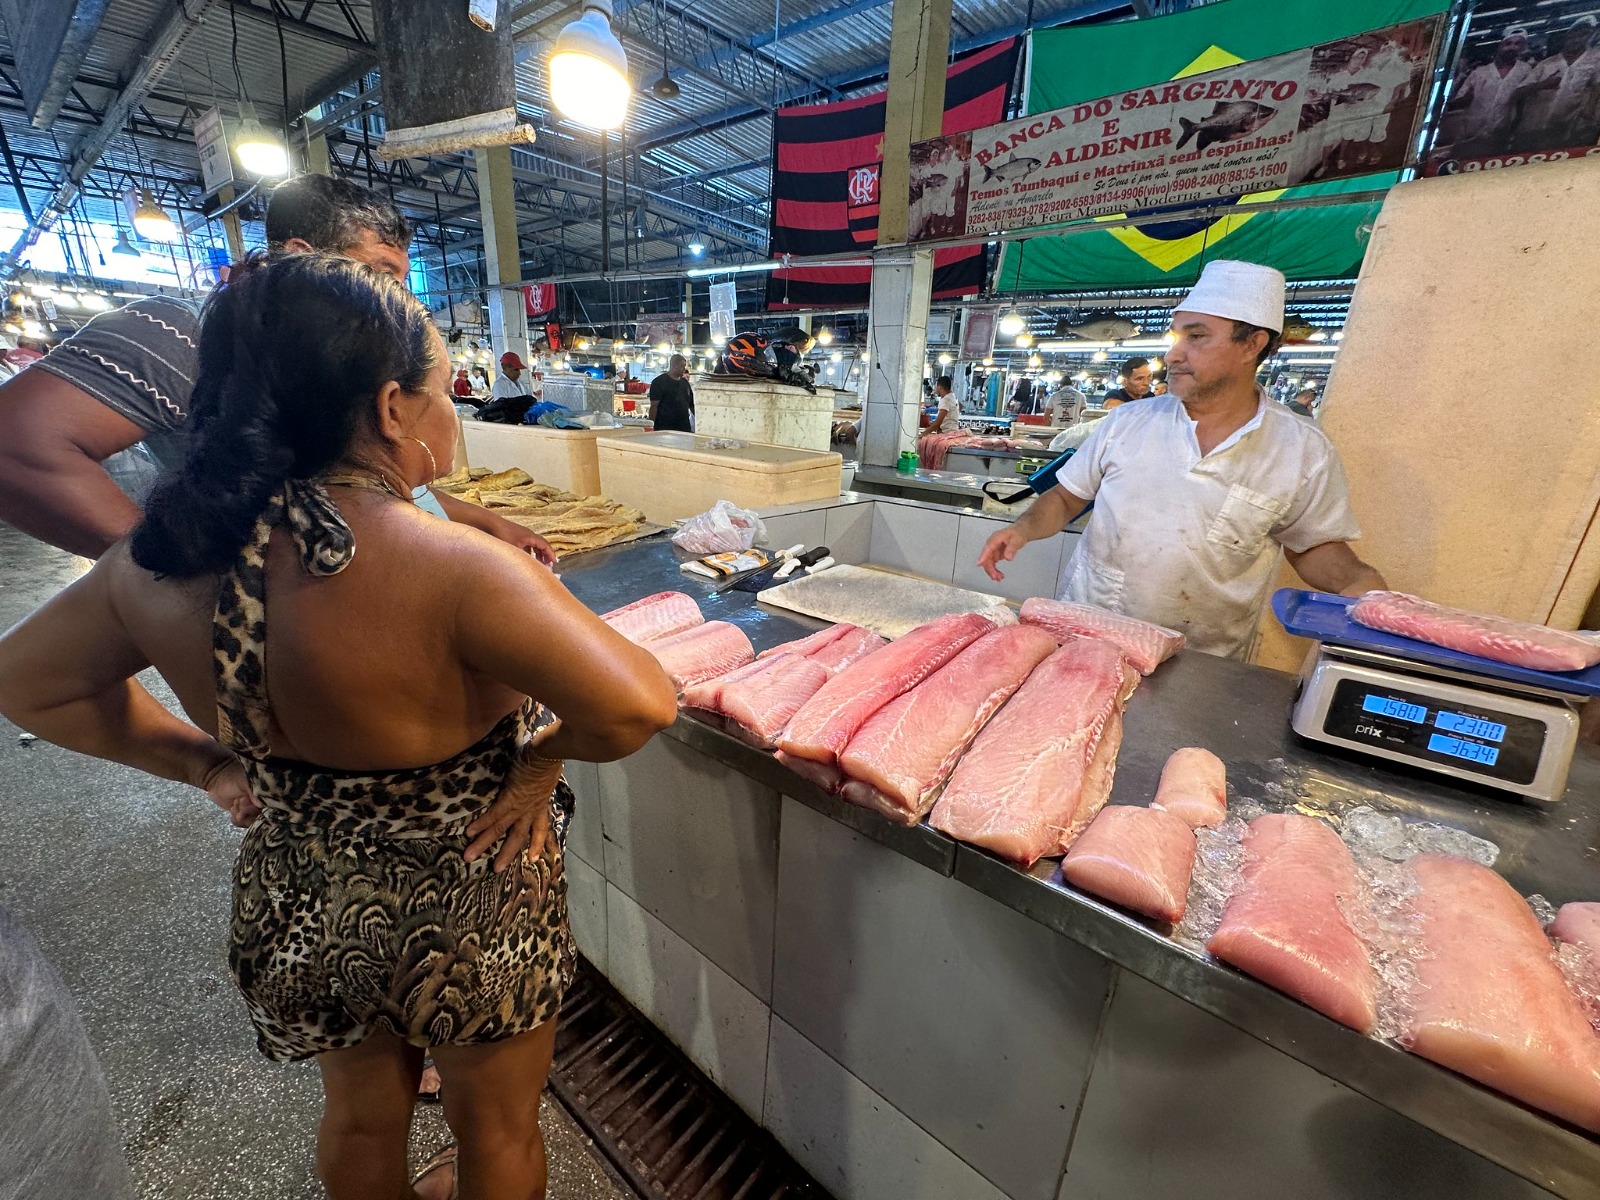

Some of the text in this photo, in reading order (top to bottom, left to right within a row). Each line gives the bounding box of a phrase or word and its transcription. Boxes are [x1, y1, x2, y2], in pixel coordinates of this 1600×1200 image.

[974, 79, 1298, 167] BANCA DO SARGENTO
[1101, 118, 1120, 138] E
[969, 130, 1294, 201] Temos Tambaqui e Matrinxã sem espinhas!
[1044, 127, 1173, 169] ALDENIR
[1093, 180, 1105, 191] Se
[1108, 177, 1129, 188] Deus
[1136, 173, 1152, 185] por
[1175, 166, 1199, 179] quem
[1201, 159, 1221, 171] será
[1223, 155, 1252, 168] contra
[1255, 147, 1280, 161] nós?
[966, 225, 988, 235] Box
[1041, 207, 1072, 223] Feira
[1076, 203, 1129, 218] Manaus
[1133, 191, 1201, 209] Moderna
[957, 419, 989, 430] ngelados
[1354, 724, 1383, 738] prix
